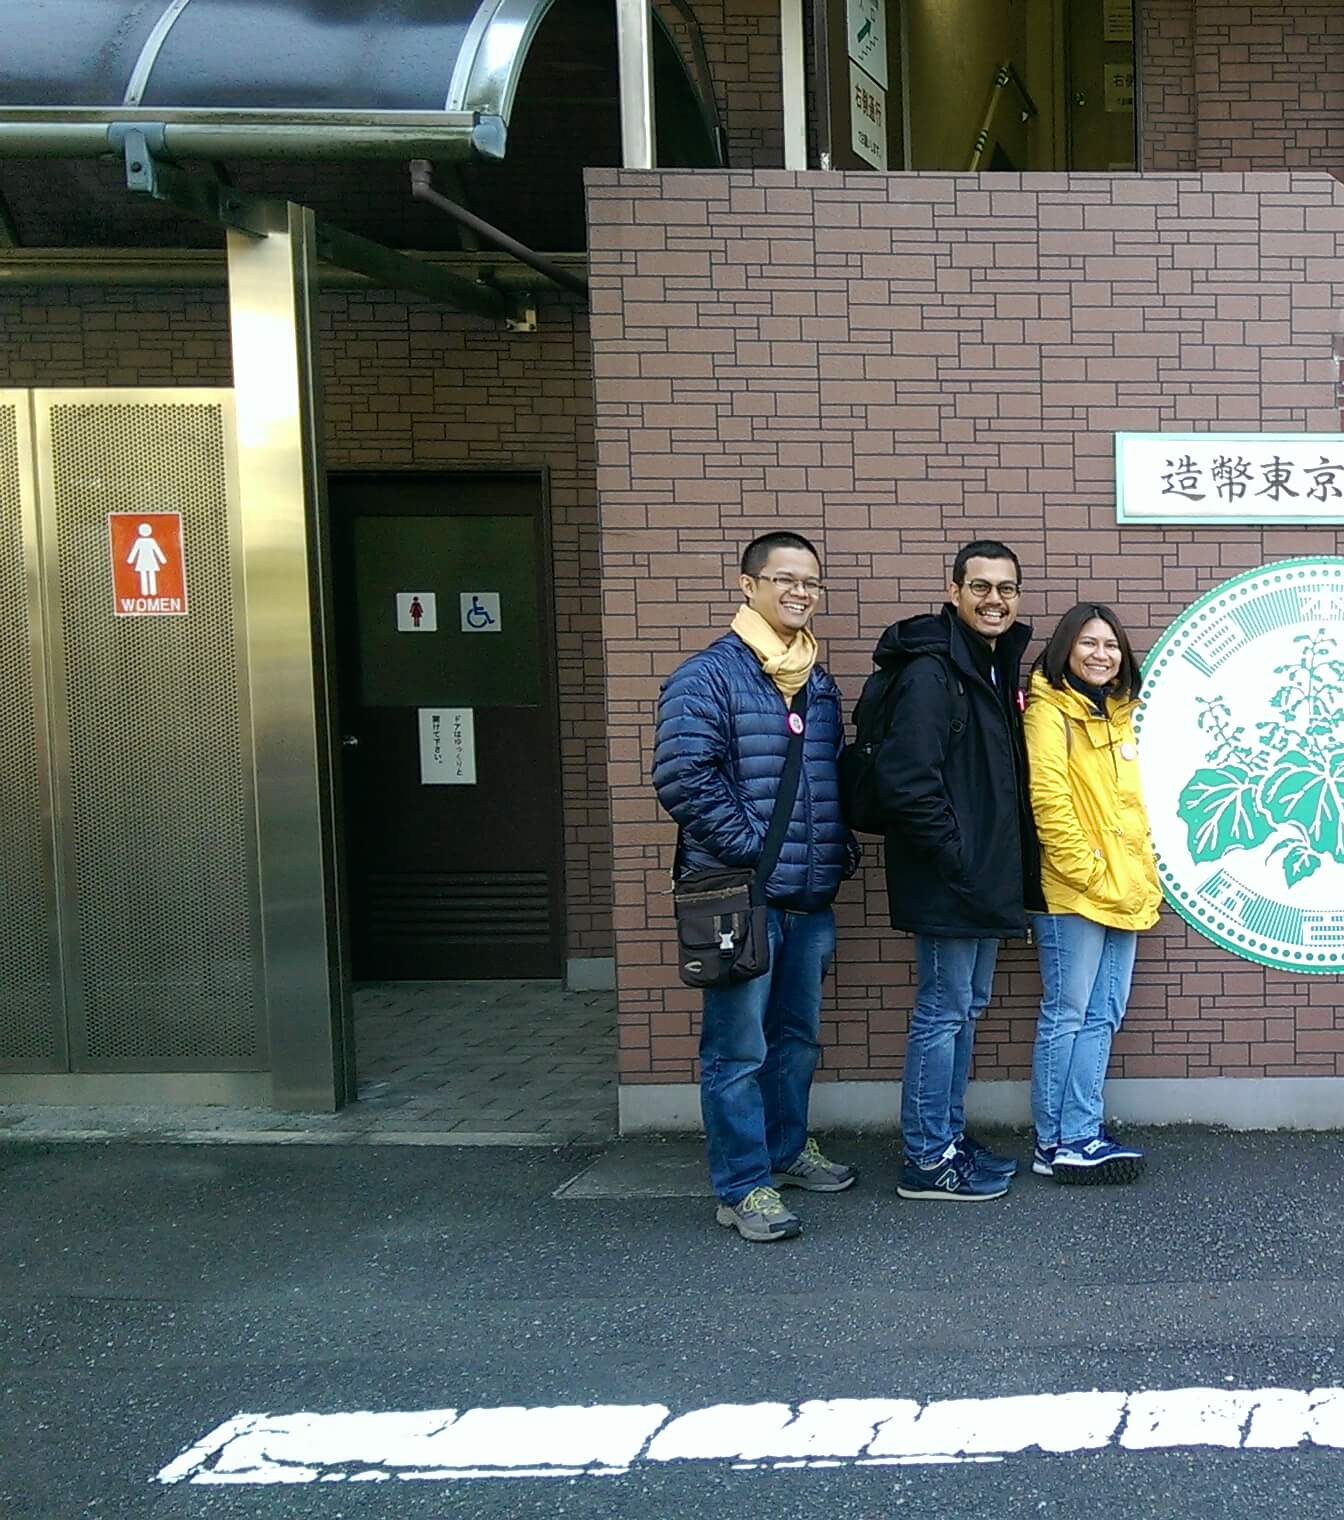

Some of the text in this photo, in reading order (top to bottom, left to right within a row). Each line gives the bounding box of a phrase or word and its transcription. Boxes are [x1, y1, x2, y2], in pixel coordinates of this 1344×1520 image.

[121, 598, 181, 613] WOMEN
[452, 714, 464, 776] ドアはゆっくりと
